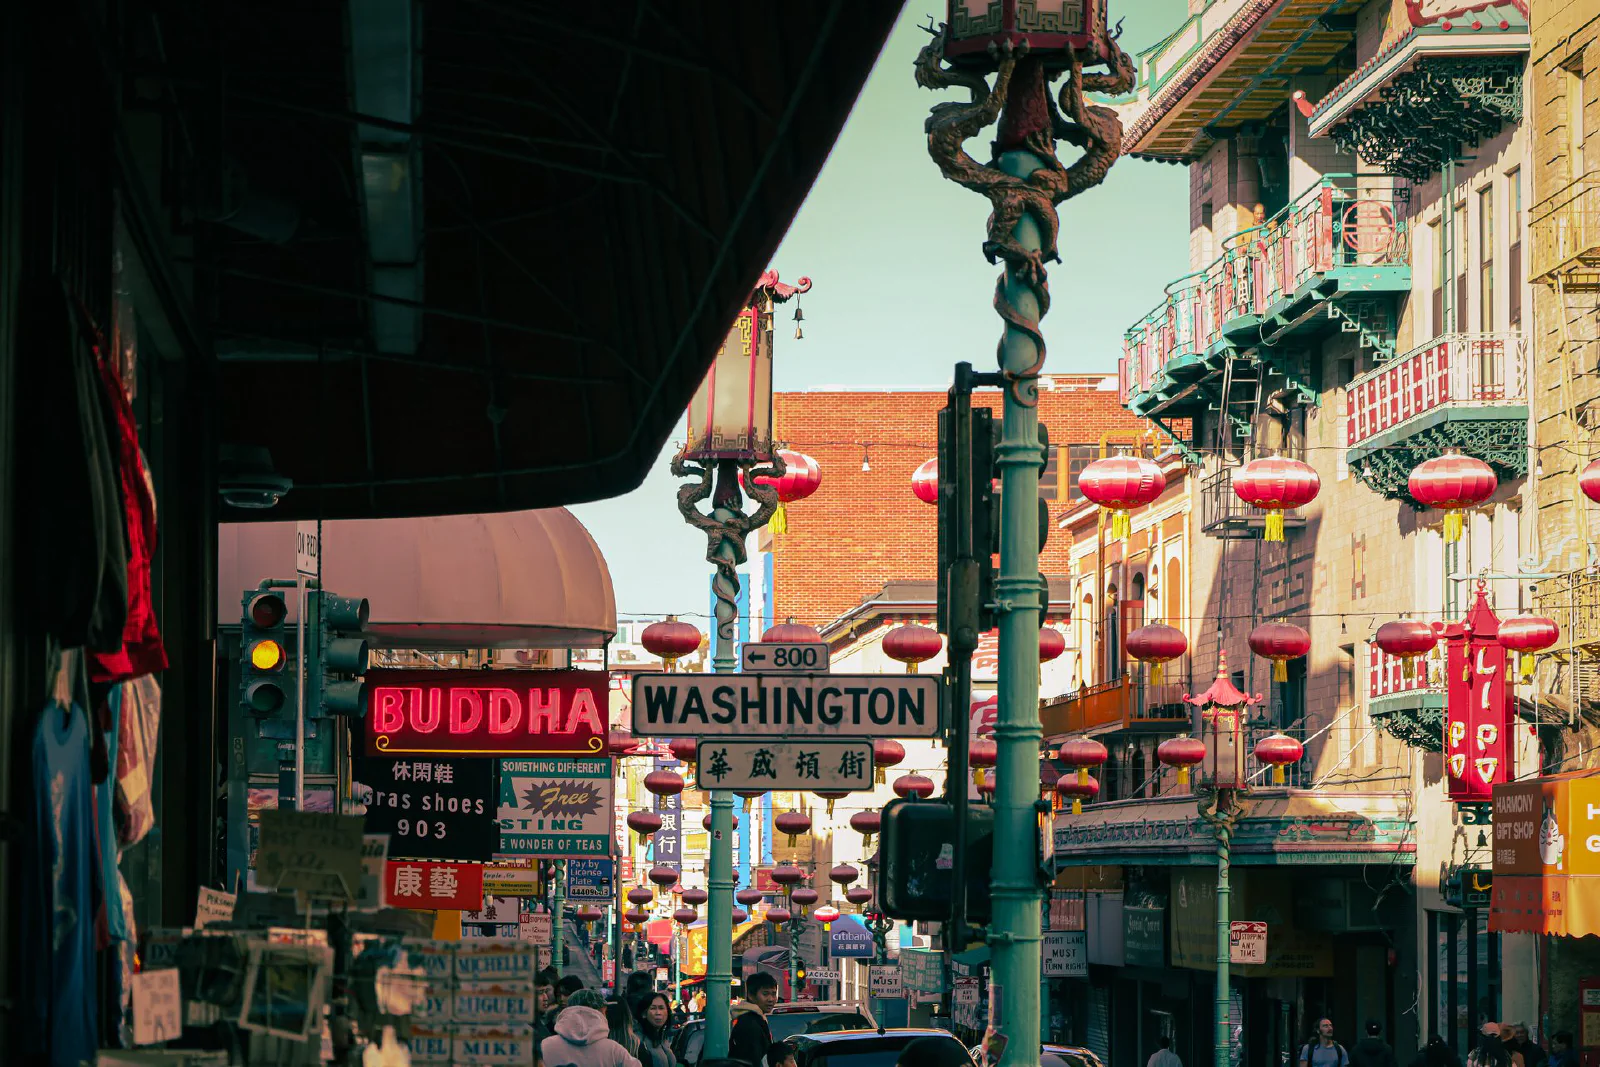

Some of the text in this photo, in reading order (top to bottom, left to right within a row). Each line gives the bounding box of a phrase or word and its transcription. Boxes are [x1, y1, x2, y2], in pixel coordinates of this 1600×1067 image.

[297, 532, 317, 557] ON RED
[773, 647, 818, 667] 800
[374, 687, 604, 734] BUDDHA
[644, 685, 925, 725] WASHINGTON
[502, 761, 606, 774] SOMETHING DIFFERENT
[706, 747, 866, 783] 華盛頓街
[422, 792, 484, 815] shoes
[540, 787, 590, 810] Free
[1496, 794, 1534, 813] HARMONY
[397, 818, 446, 839] 903
[1496, 821, 1534, 840] GIFT SHOP
[511, 838, 553, 850] WONDER
[558, 839, 571, 850] OF
[576, 840, 602, 851] TEAS
[570, 859, 600, 870] Pay by
[570, 868, 603, 877] License
[394, 864, 458, 899] 康藝
[570, 876, 593, 885] Plate
[832, 930, 871, 941] citibank
[1044, 936, 1084, 945] RIGHT LANE
[1231, 931, 1265, 941] NO STOPPING
[1052, 949, 1077, 958] MUST
[1065, 962, 1086, 970] RIGHT
[463, 1040, 521, 1056] MIKE
